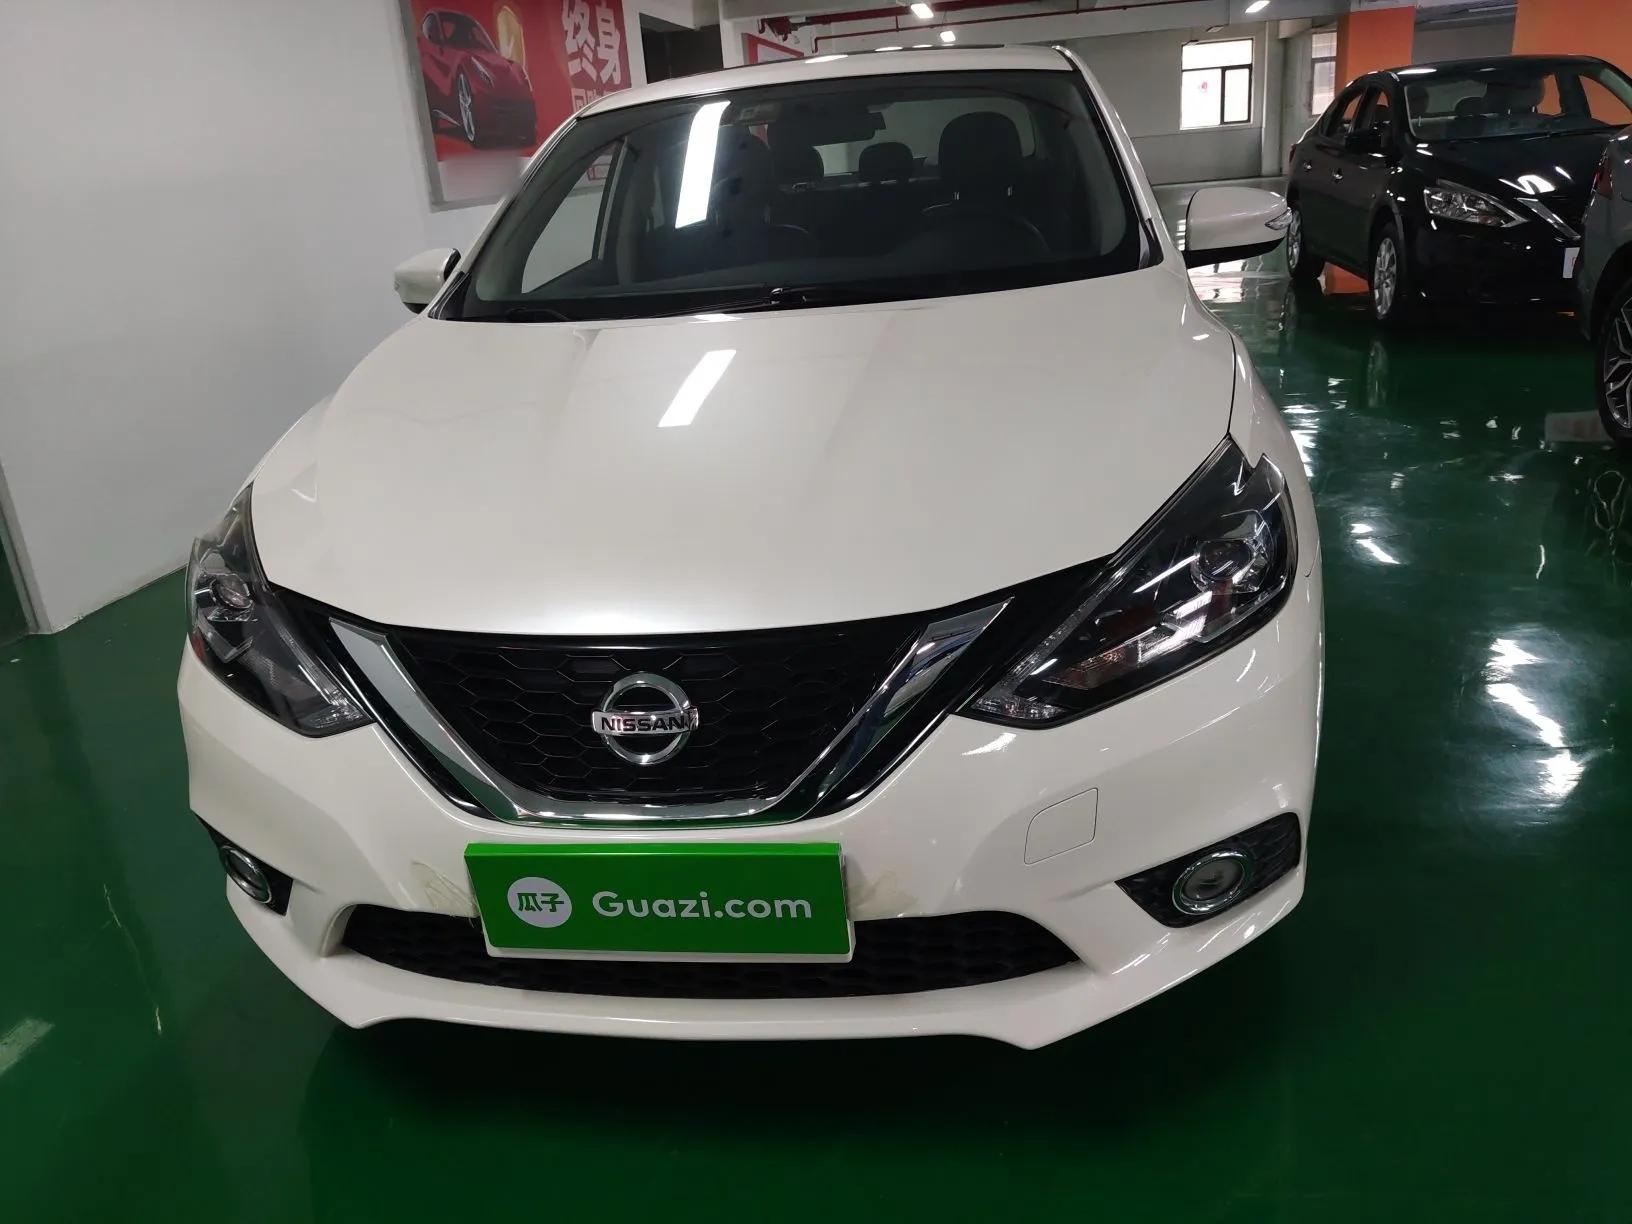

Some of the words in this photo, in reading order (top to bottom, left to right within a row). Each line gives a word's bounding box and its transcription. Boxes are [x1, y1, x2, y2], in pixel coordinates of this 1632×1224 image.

[561, 0, 621, 85] 终身
[601, 716, 685, 732] NISSAN
[516, 892, 565, 913] 瓜子
[592, 891, 812, 918] Guazi.com
